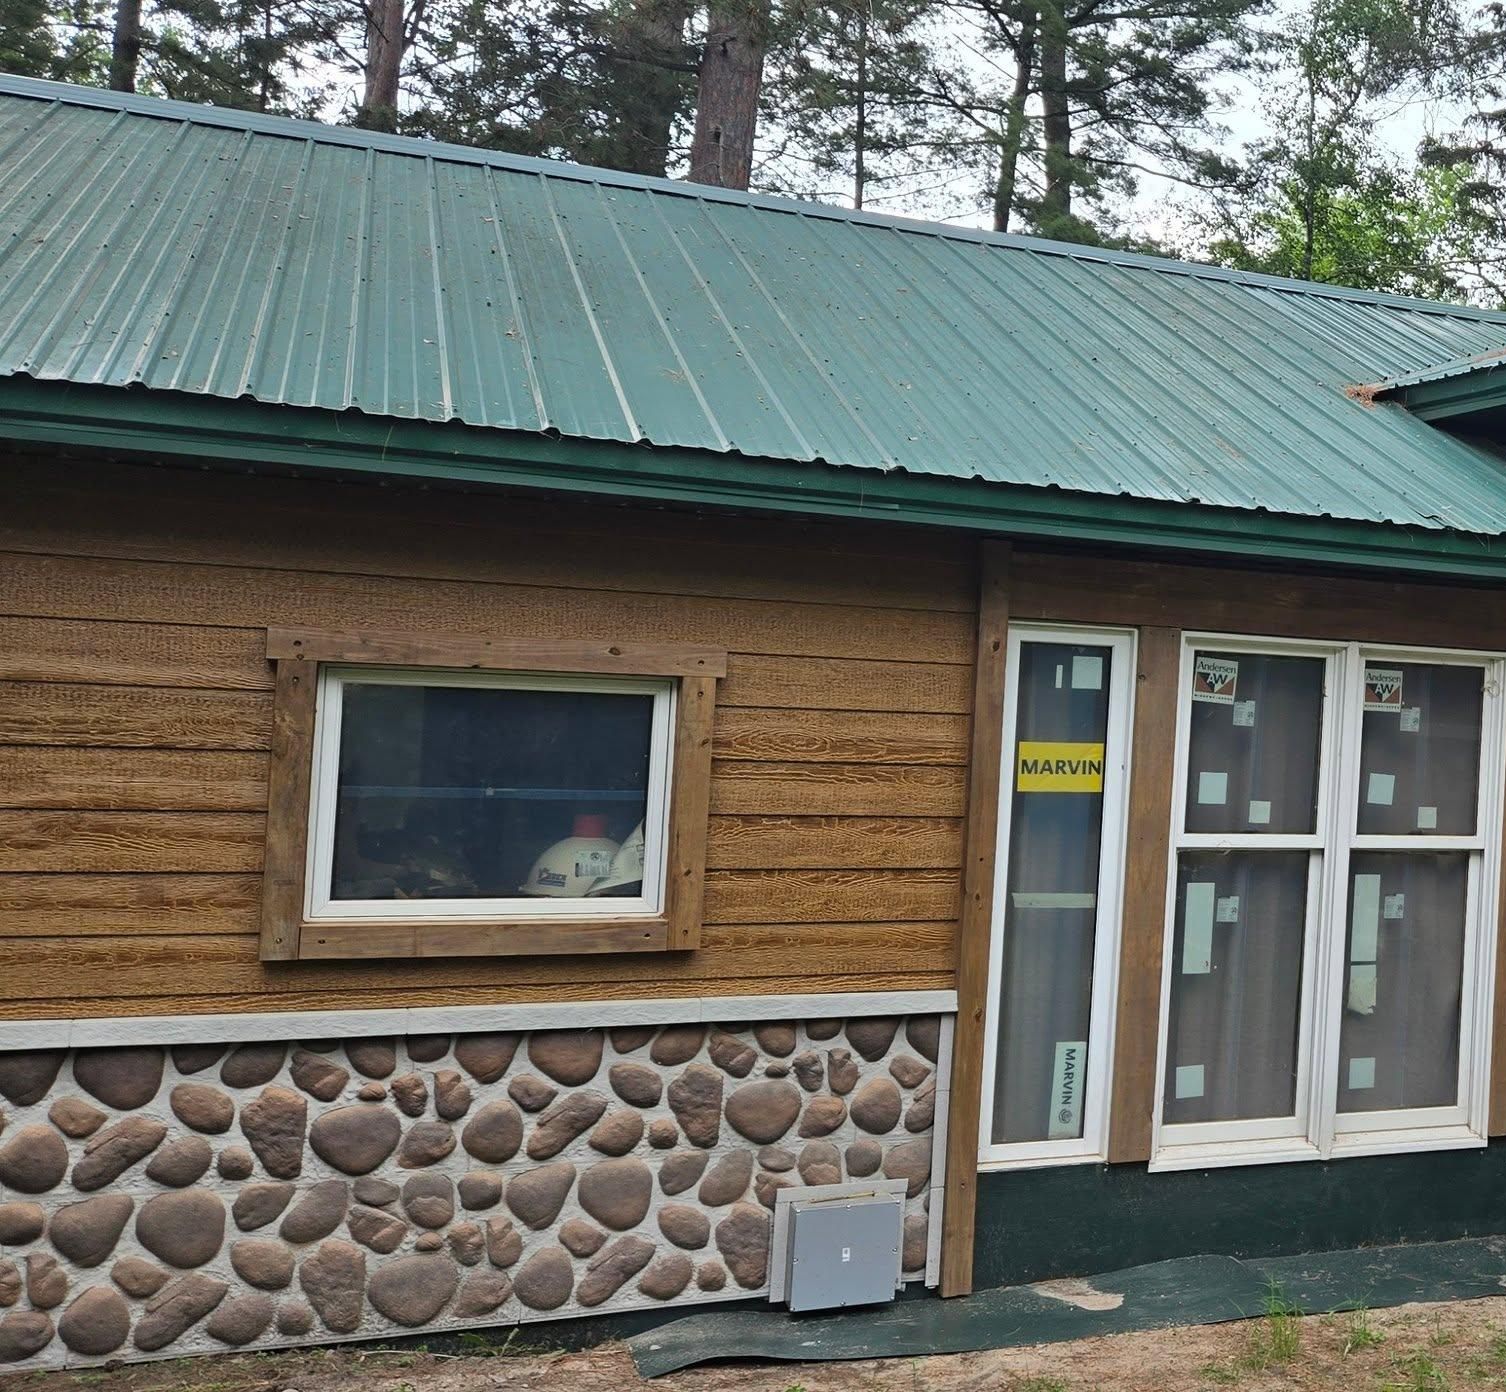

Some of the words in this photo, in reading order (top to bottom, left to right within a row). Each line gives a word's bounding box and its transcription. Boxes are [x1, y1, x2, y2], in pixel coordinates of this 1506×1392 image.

[1197, 660, 1236, 674] Andersen
[1021, 759, 1101, 775] MARVIN
[1061, 1048, 1077, 1105] MARVIN
